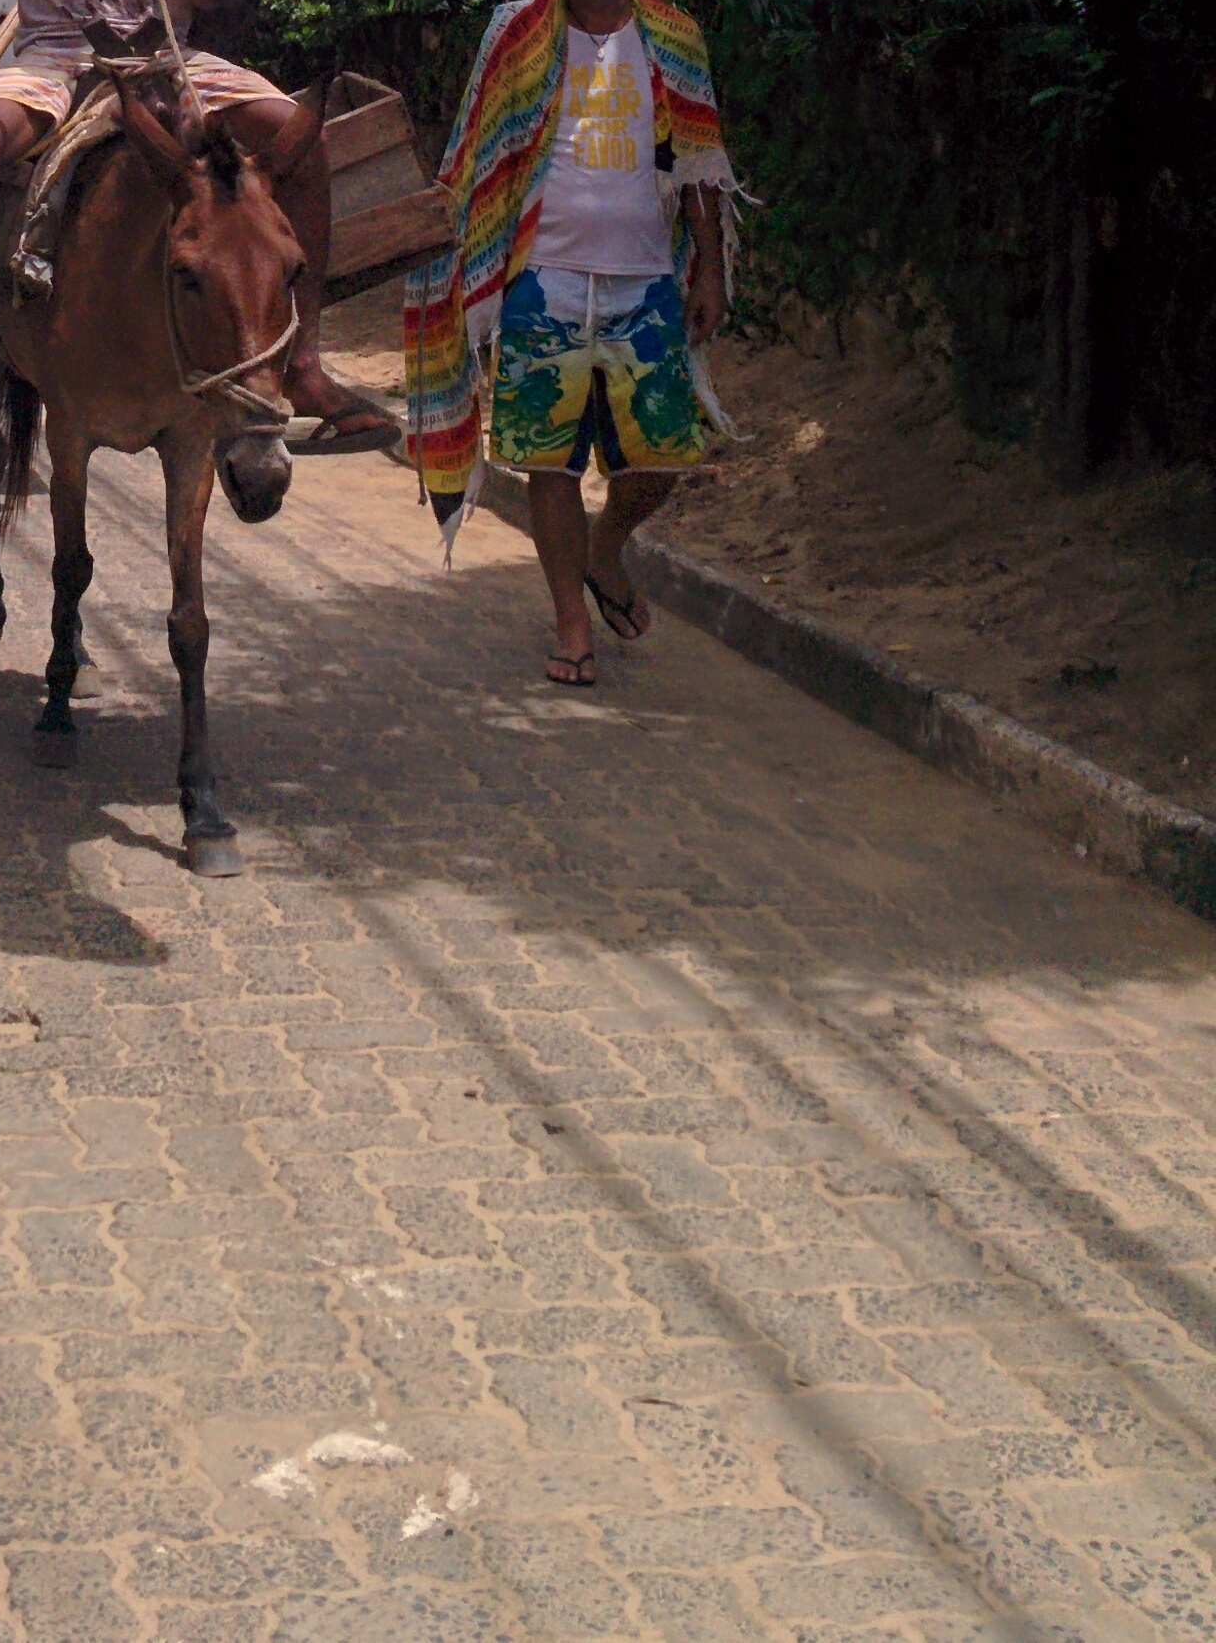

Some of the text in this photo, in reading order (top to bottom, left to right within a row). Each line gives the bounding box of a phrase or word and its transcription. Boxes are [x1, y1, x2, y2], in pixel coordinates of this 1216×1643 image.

[568, 63, 636, 89] MAIS
[567, 90, 642, 118] AMOR
[572, 134, 637, 172] FAVOR
